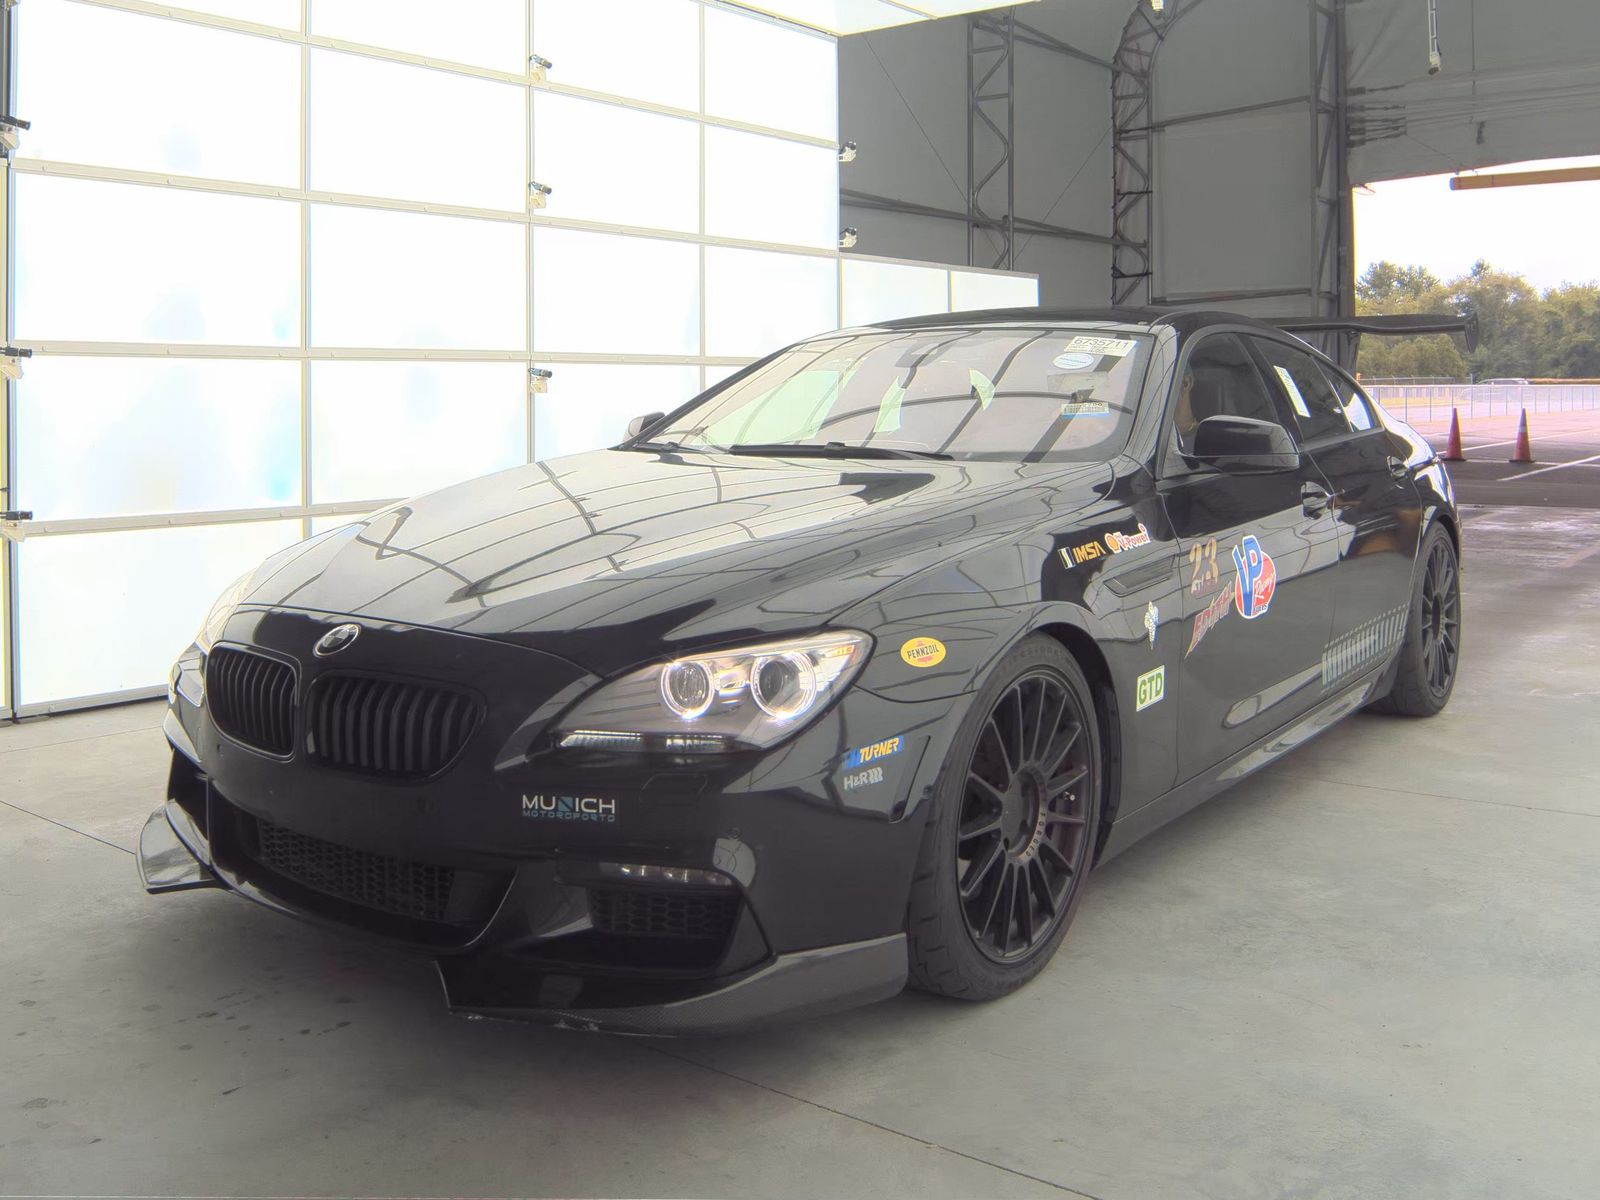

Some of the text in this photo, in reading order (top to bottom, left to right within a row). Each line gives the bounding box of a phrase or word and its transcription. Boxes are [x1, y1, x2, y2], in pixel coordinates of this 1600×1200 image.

[1074, 337, 1128, 349] 6735711
[1072, 541, 1106, 564] IMSA
[907, 644, 939, 660] PENNZOIL
[1139, 672, 1163, 705] GTD
[860, 737, 899, 763] TURNER
[522, 795, 616, 814] MUNICH
